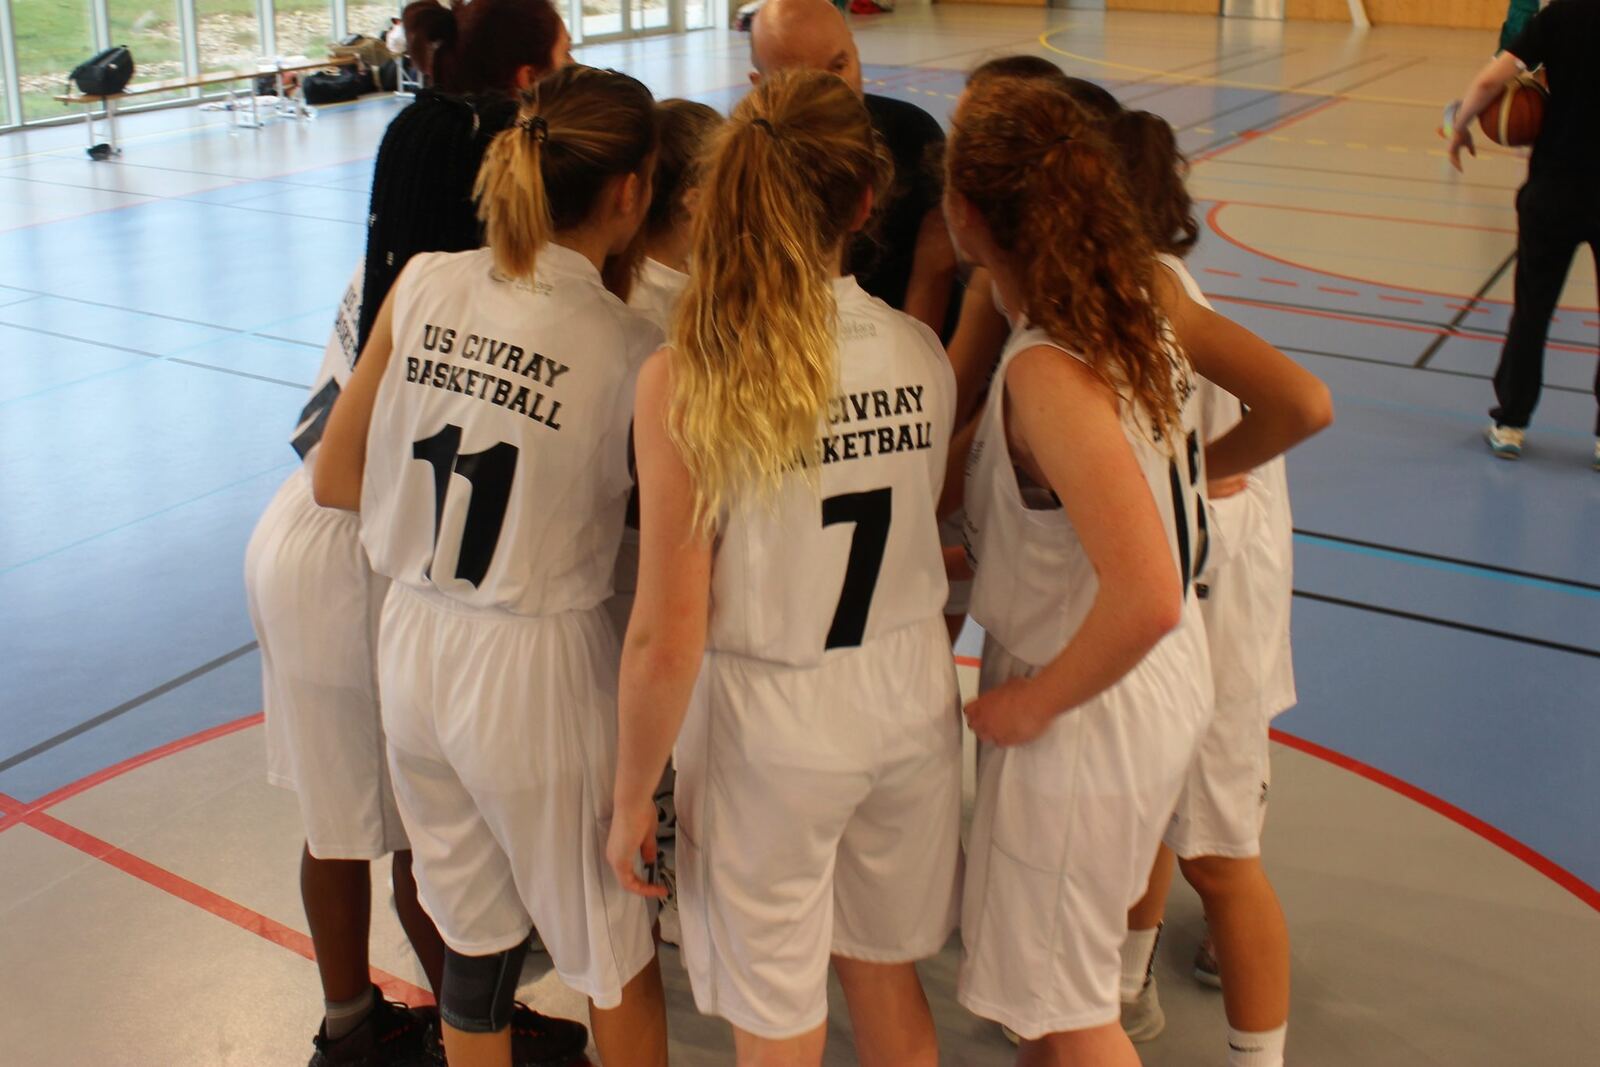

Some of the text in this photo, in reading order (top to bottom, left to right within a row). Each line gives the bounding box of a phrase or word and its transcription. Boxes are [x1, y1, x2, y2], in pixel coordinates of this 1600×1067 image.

[406, 356, 562, 431] BASKETBALL
[423, 324, 570, 388] US CIVRAY
[412, 423, 519, 590] 11
[822, 486, 893, 652] 7
